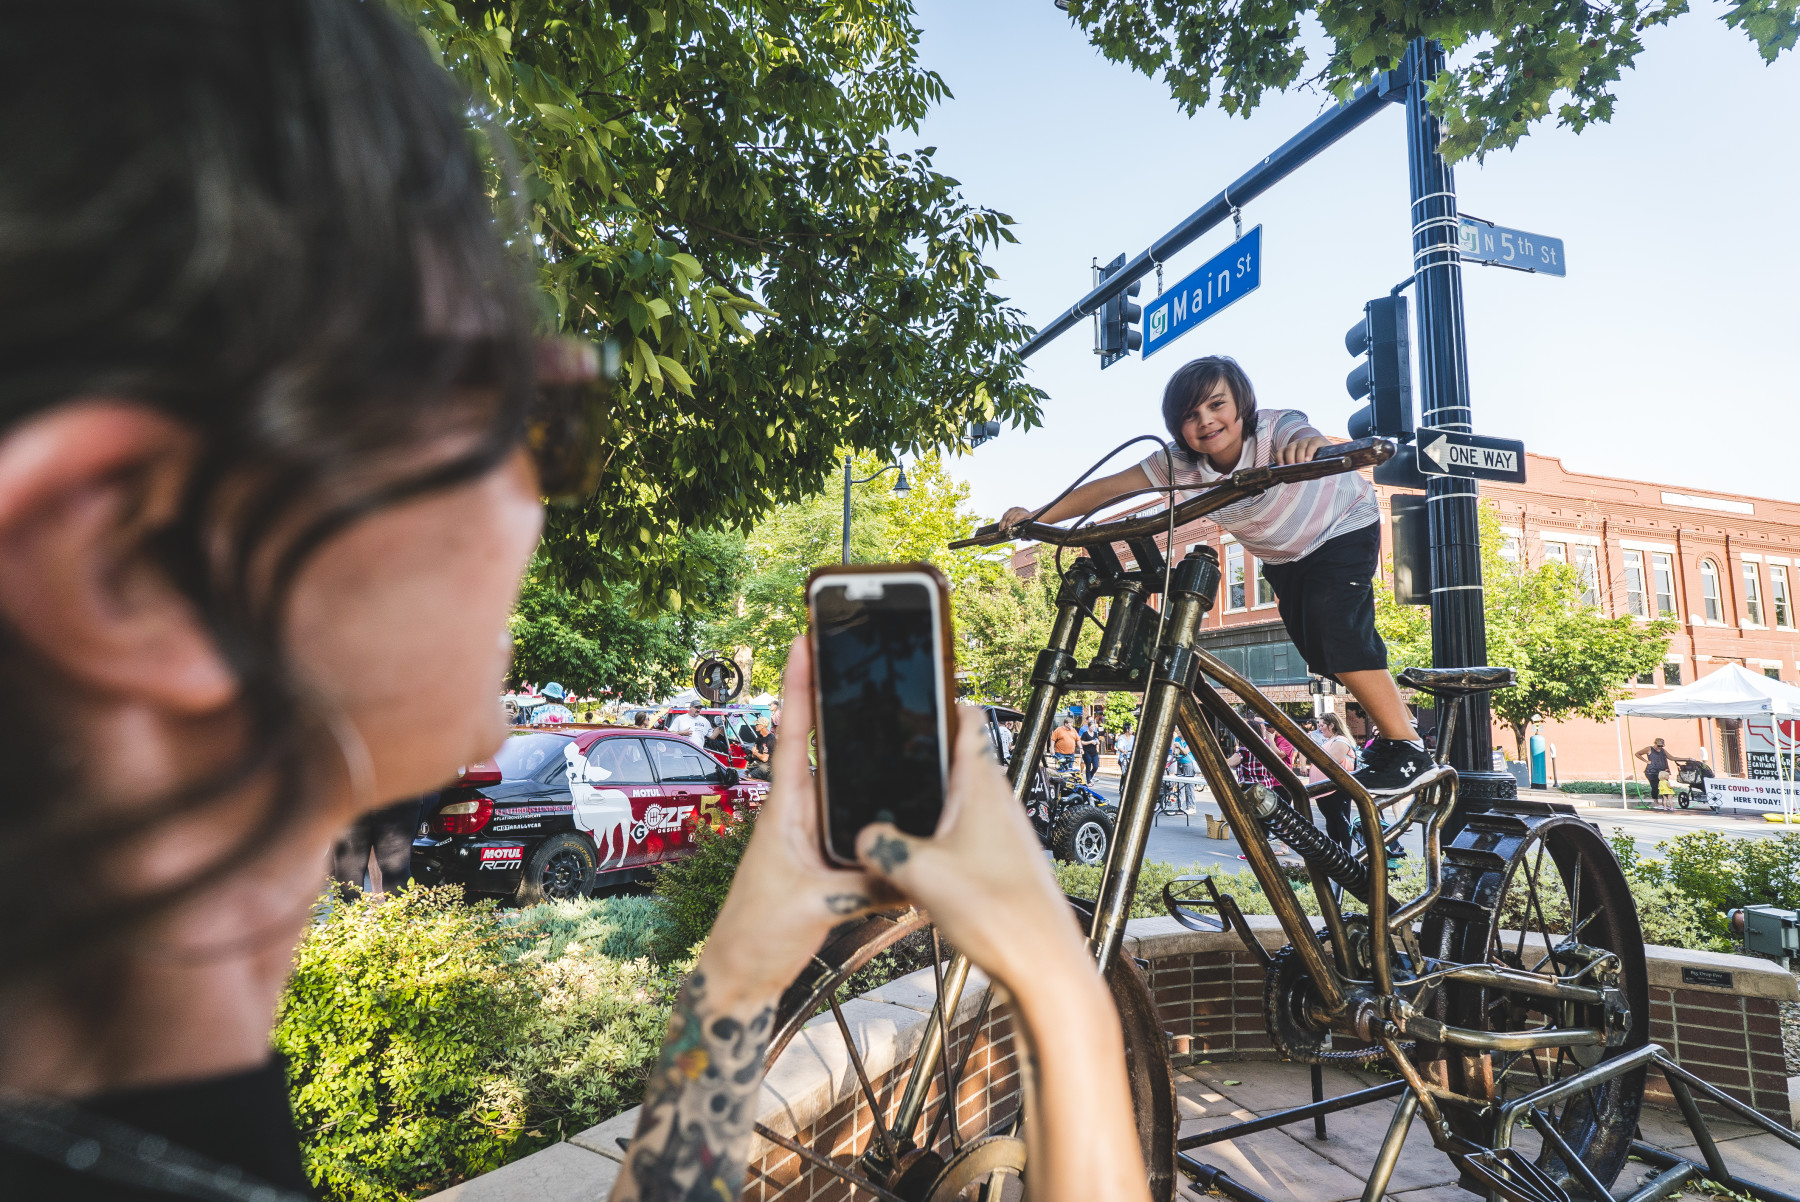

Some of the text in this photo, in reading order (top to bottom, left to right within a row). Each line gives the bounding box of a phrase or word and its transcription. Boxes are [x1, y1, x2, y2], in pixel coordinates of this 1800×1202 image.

[1484, 233, 1495, 253] N
[1501, 232, 1534, 261] 5th
[1541, 245, 1557, 265] St
[1151, 252, 1252, 335] GJ Main St
[1449, 446, 1513, 469] ONE WAY
[632, 788, 661, 798] MOTUL
[1710, 783, 1727, 791] FREE
[1728, 785, 1764, 794] COVID-19
[1753, 797, 1781, 806] TODAY!
[633, 824, 645, 840] G
[482, 848, 522, 860] MOTUL
[563, 842, 593, 868] SCORPION
[479, 860, 522, 871] RCM
